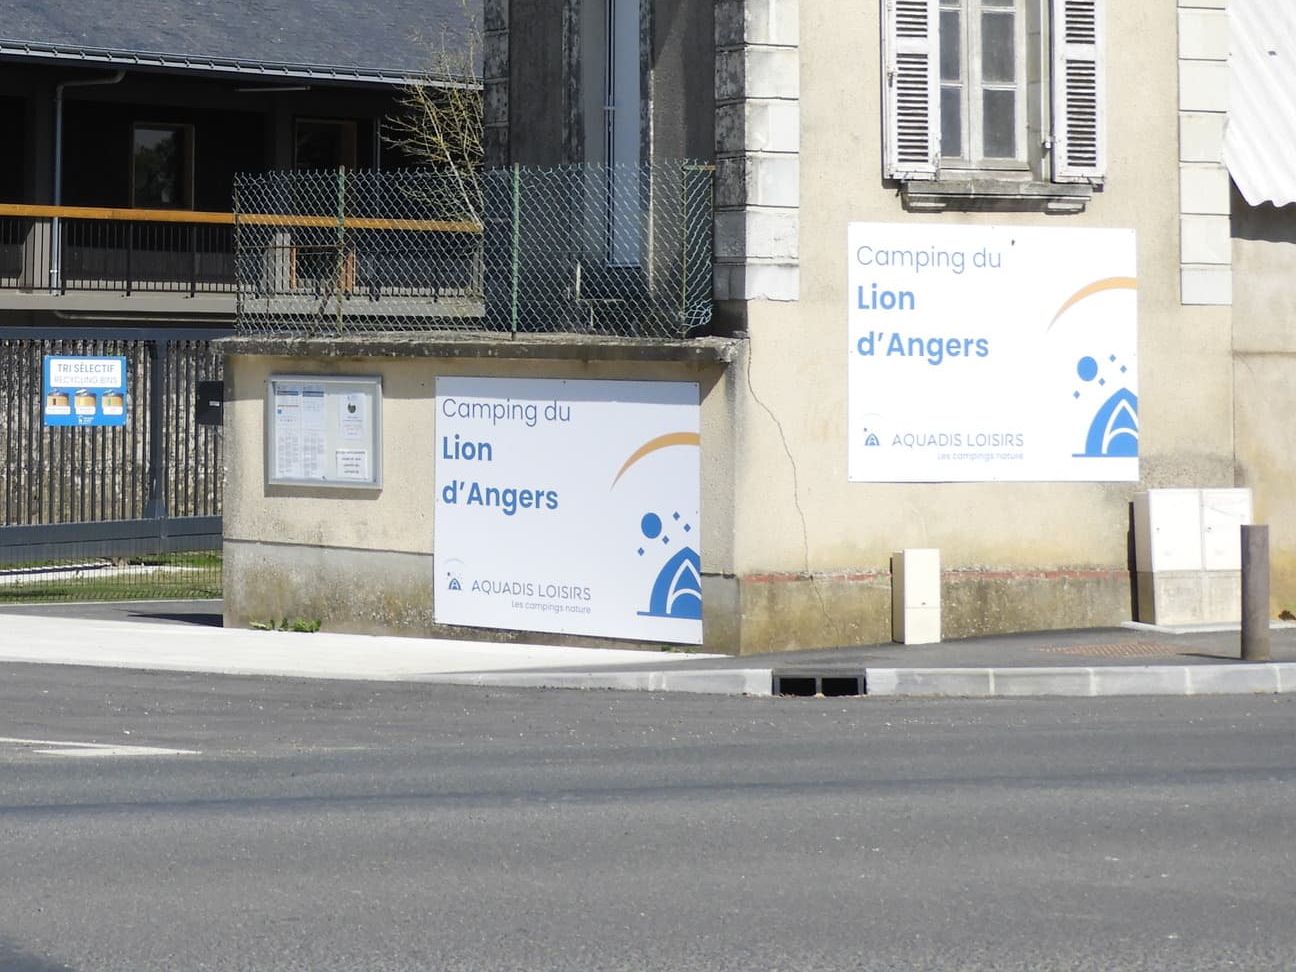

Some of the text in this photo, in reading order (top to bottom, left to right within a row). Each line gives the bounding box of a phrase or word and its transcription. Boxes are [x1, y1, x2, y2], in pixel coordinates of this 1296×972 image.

[857, 245, 1001, 274] Camping du
[857, 282, 916, 310] Lion
[856, 331, 990, 366] d'Angers
[57, 361, 115, 373] TRI SÉLECTIF
[442, 398, 570, 427] Camping du
[443, 434, 492, 461] Lion
[891, 433, 1024, 448] AQUADIS LOISIRS
[442, 480, 558, 516] d'Angers
[471, 579, 592, 601] AQUADIS LOISIRS
[511, 600, 592, 614] Les campings nature
